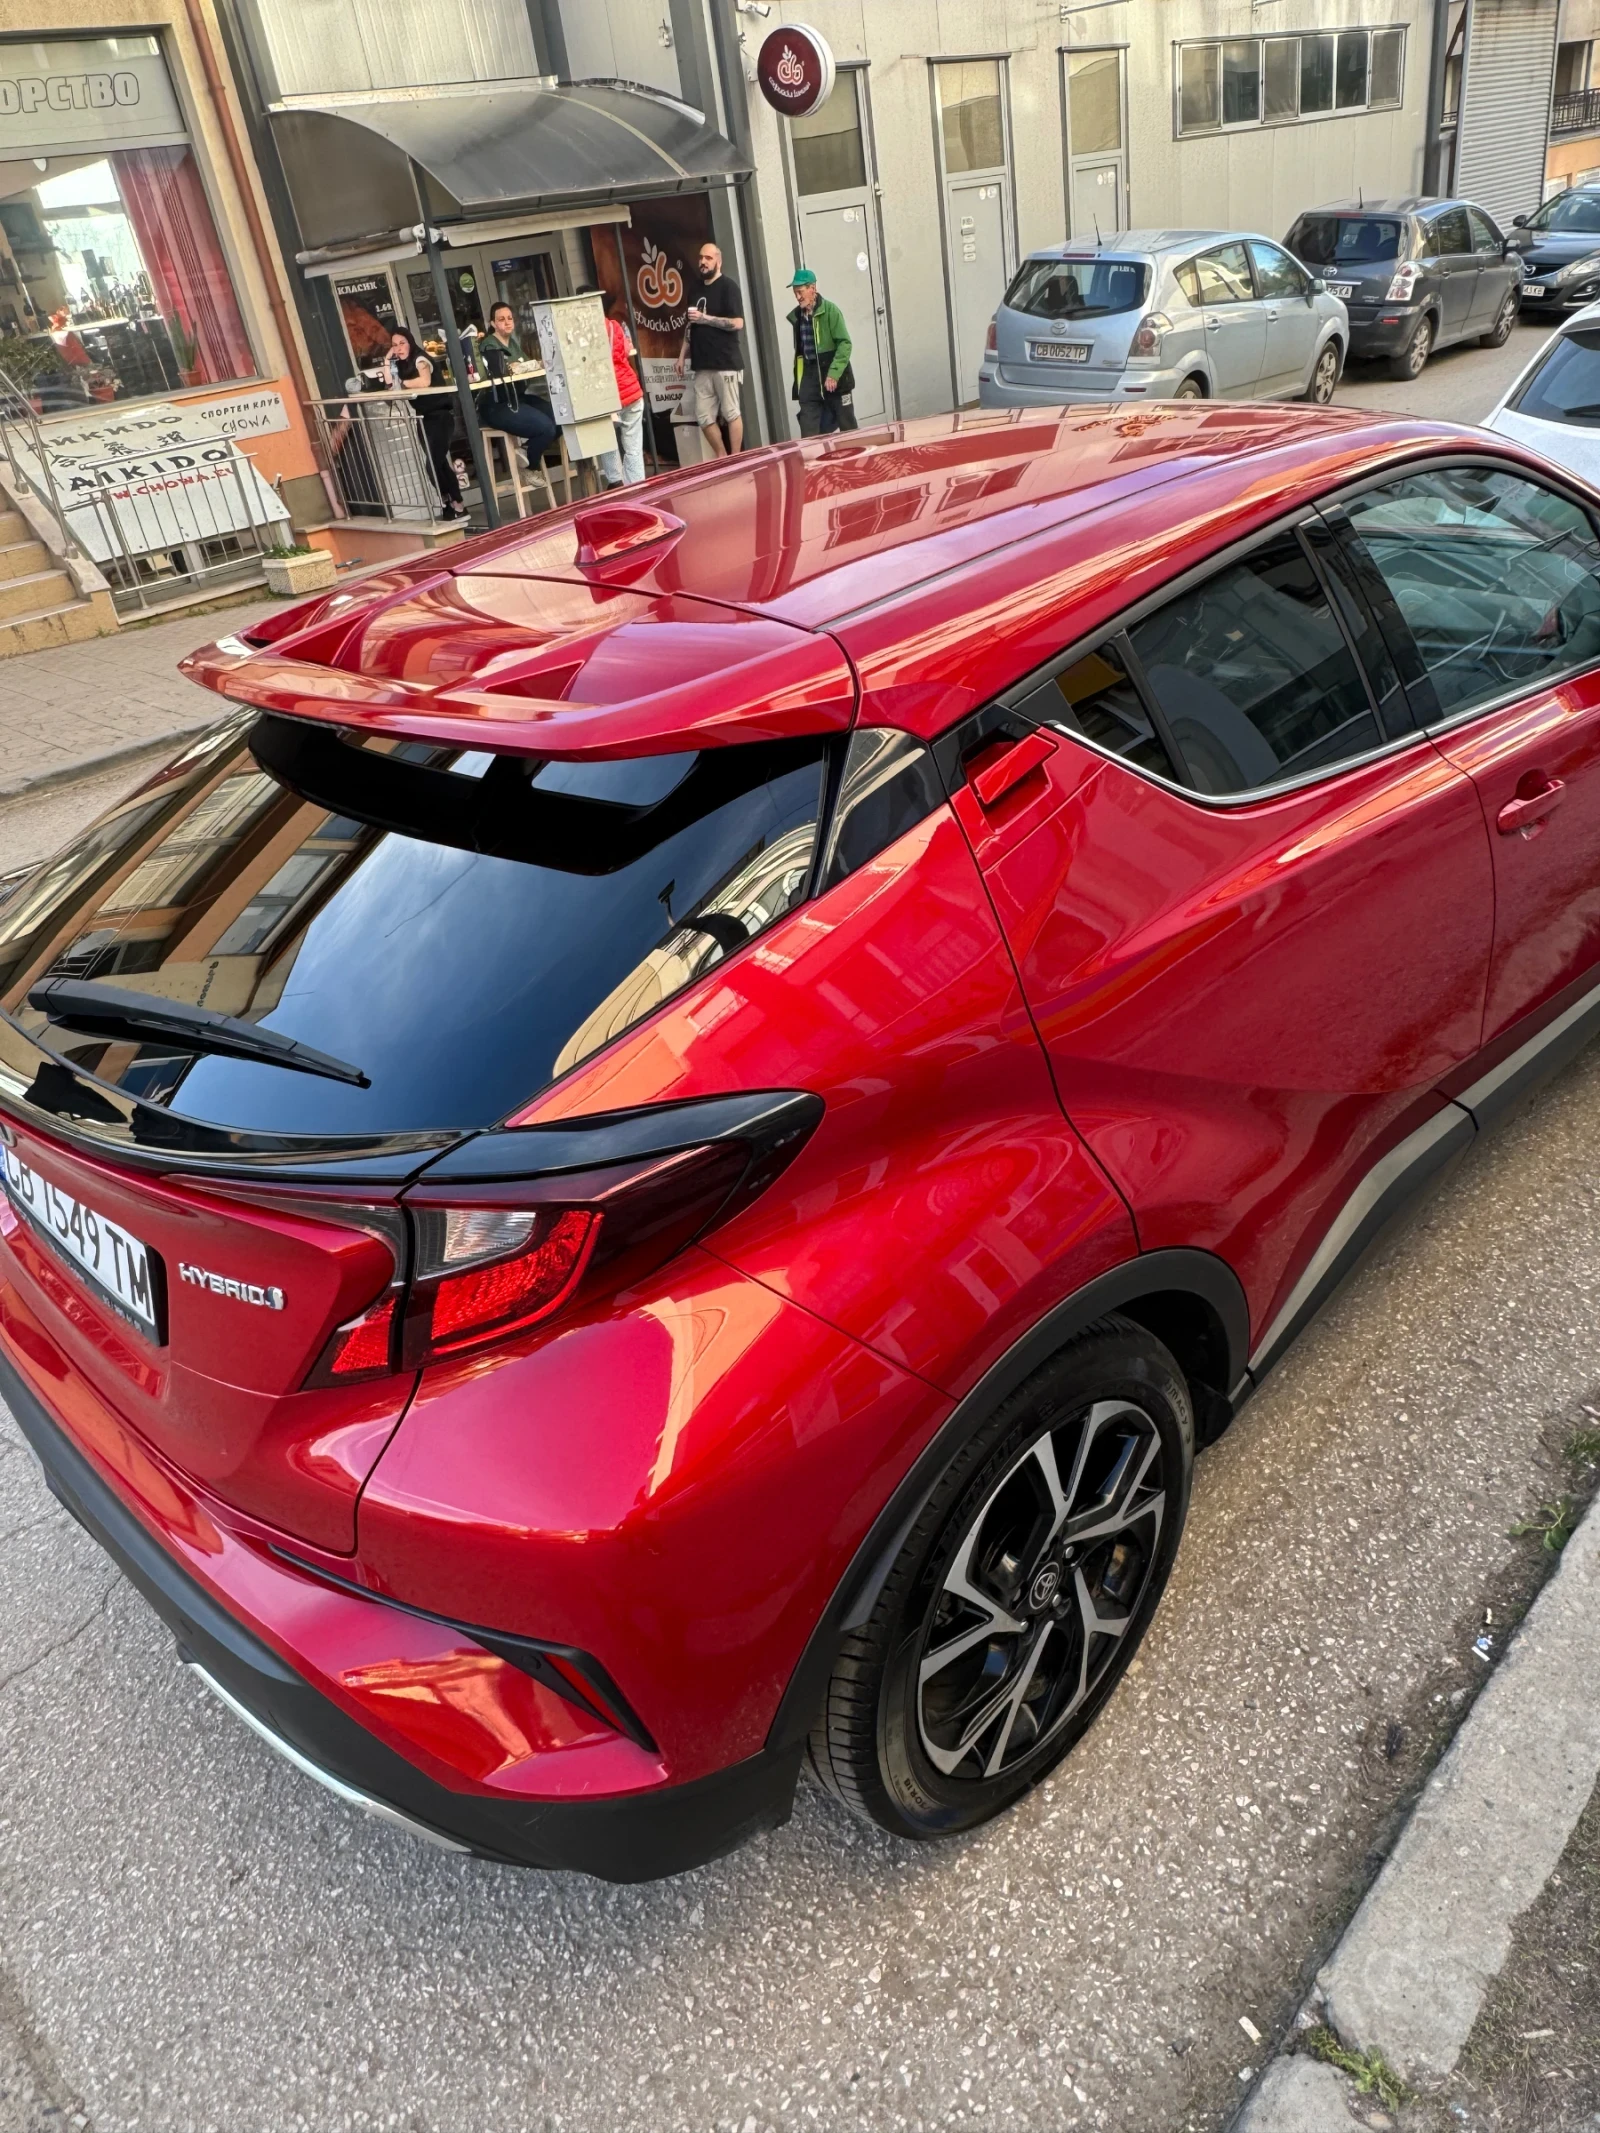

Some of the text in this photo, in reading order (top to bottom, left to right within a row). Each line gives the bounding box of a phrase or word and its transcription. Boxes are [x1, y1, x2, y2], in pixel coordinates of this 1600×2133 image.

[1036, 344, 1049, 356] CB
[1073, 347, 1086, 358] TP
[201, 397, 280, 419] СПОРТЕН КЛУБ
[221, 415, 271, 433] CHOWA
[69, 449, 229, 492] AIKIDO
[43, 1180, 101, 1270] 1549
[105, 1223, 153, 1321] TM
[179, 1262, 265, 1307] HYBRID
